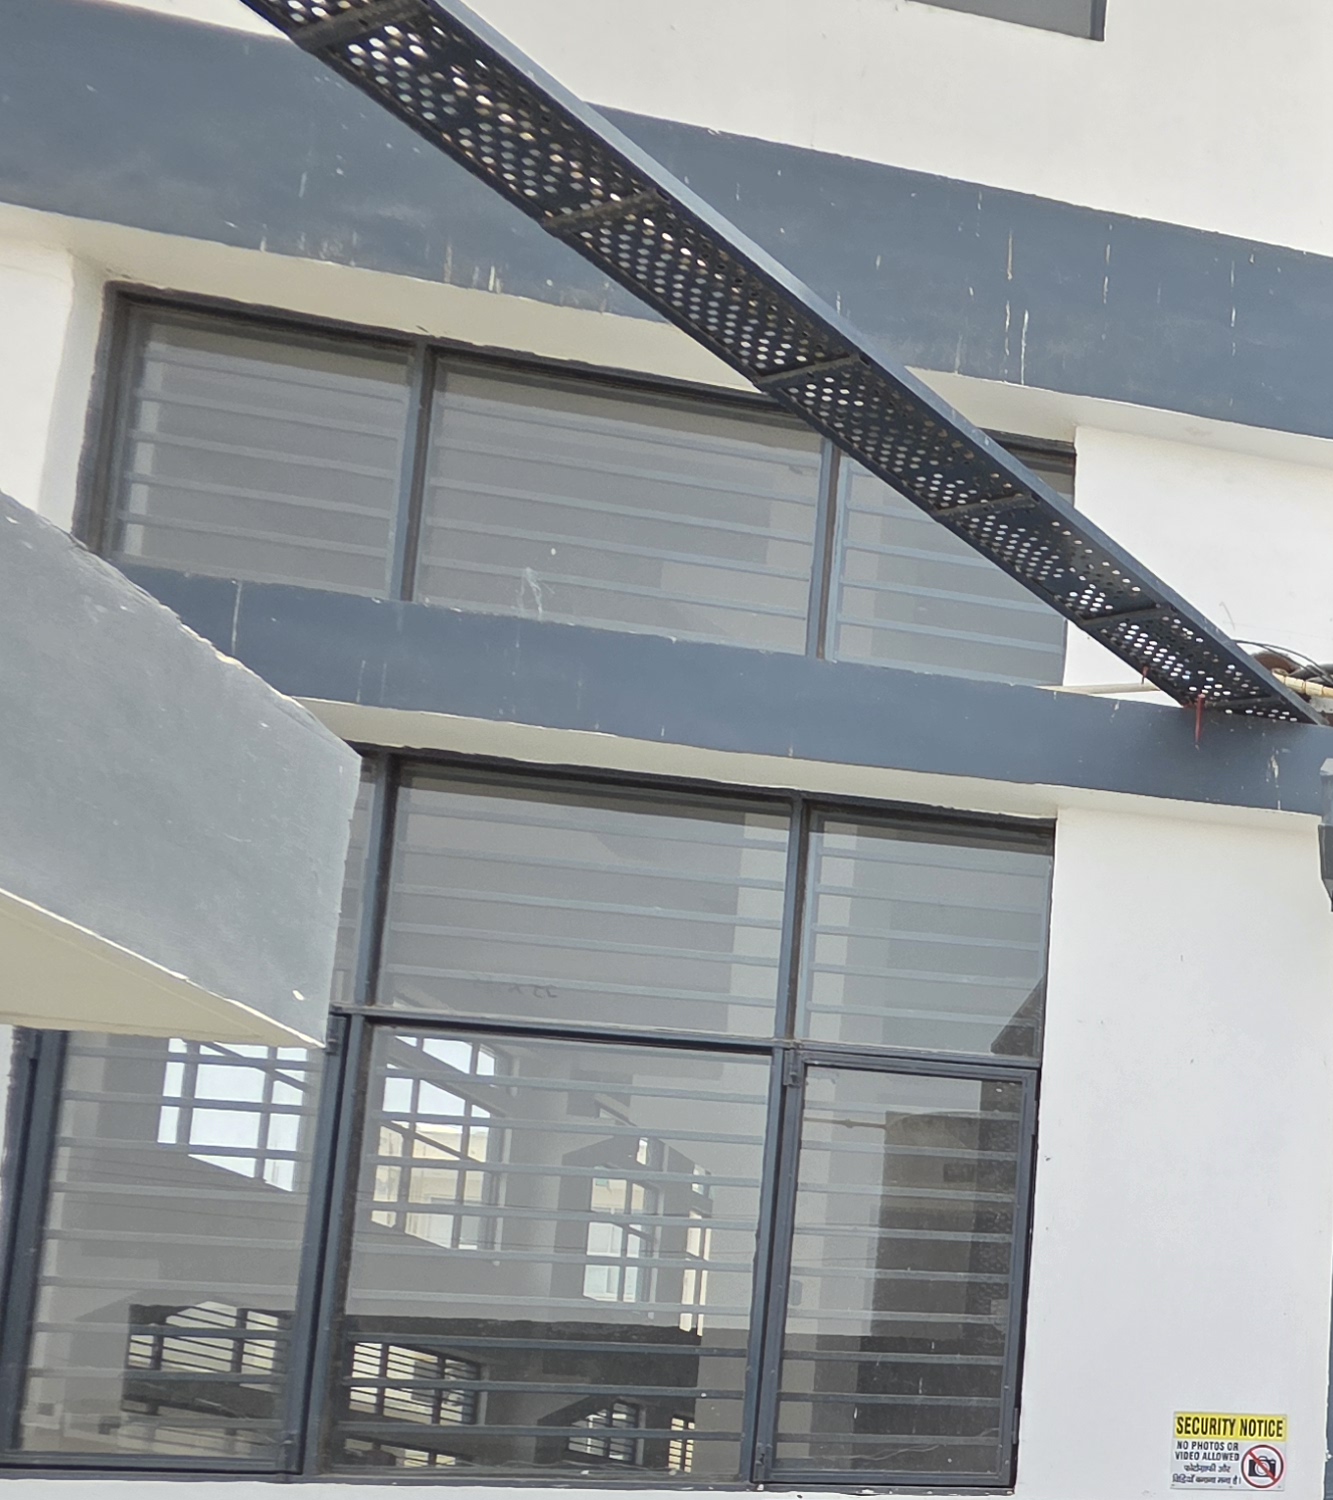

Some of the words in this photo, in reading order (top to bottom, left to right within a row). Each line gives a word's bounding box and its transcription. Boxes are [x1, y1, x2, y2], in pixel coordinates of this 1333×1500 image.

[1176, 1417, 1236, 1436] SECURITY
[1240, 1418, 1283, 1437] NOTICE
[1177, 1441, 1189, 1450] NO
[1191, 1441, 1225, 1451] PHOTOS
[1227, 1442, 1239, 1451] OR
[1175, 1451, 1200, 1460] VIDEO
[1202, 1452, 1239, 1461] ALLOWED
